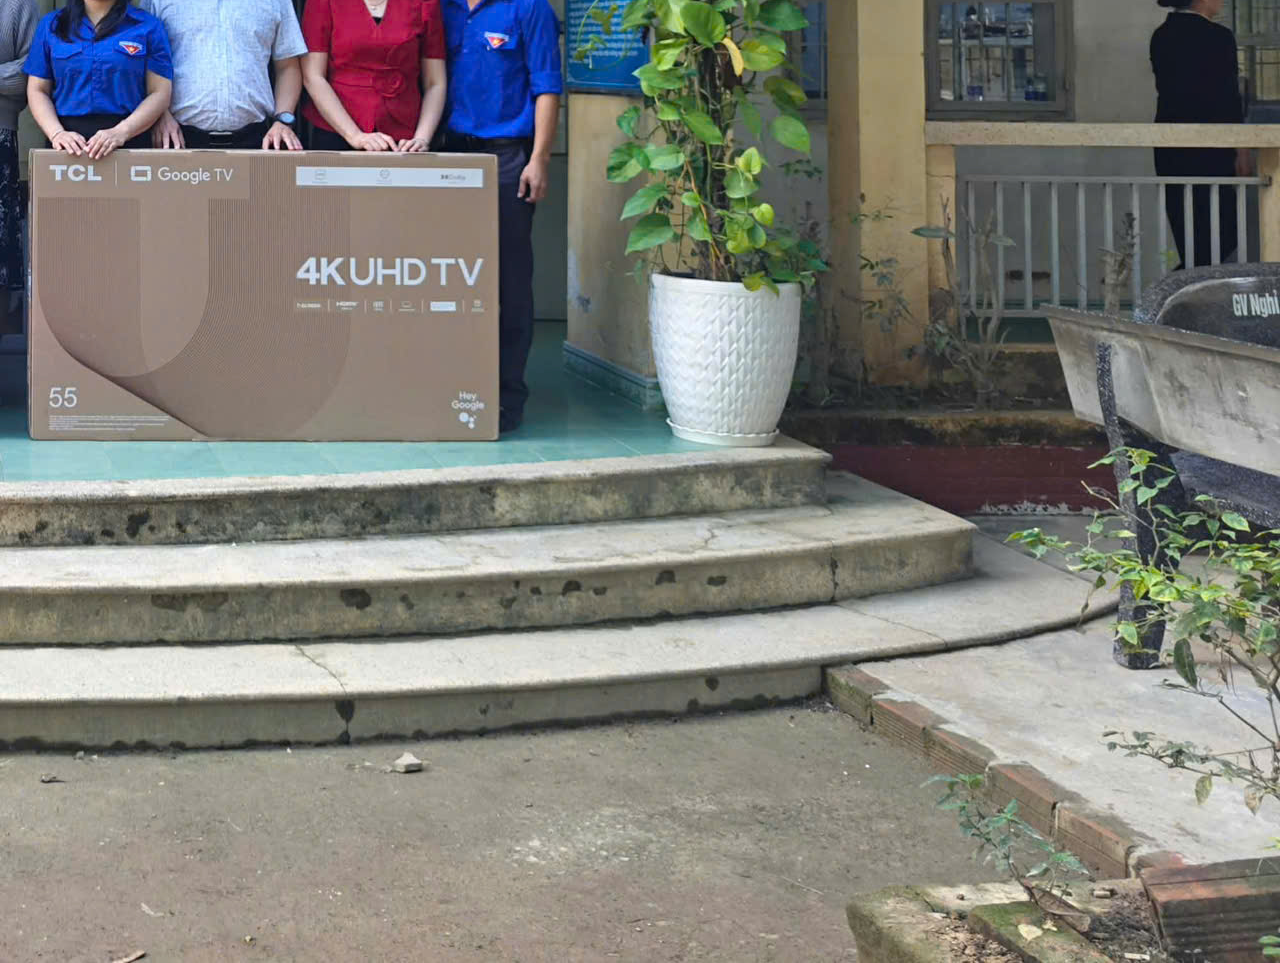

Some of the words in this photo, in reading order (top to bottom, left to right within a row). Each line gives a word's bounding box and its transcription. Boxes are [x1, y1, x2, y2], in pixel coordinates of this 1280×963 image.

[50, 165, 102, 182] TCL
[157, 167, 211, 185] Google
[215, 168, 233, 182] TV
[296, 257, 346, 286] 4K
[349, 257, 427, 286] UHD
[431, 258, 484, 286] TV
[1232, 293, 1248, 317] GV
[49, 387, 77, 408] 55
[451, 399, 485, 411] Google
[458, 390, 478, 403] Hey
